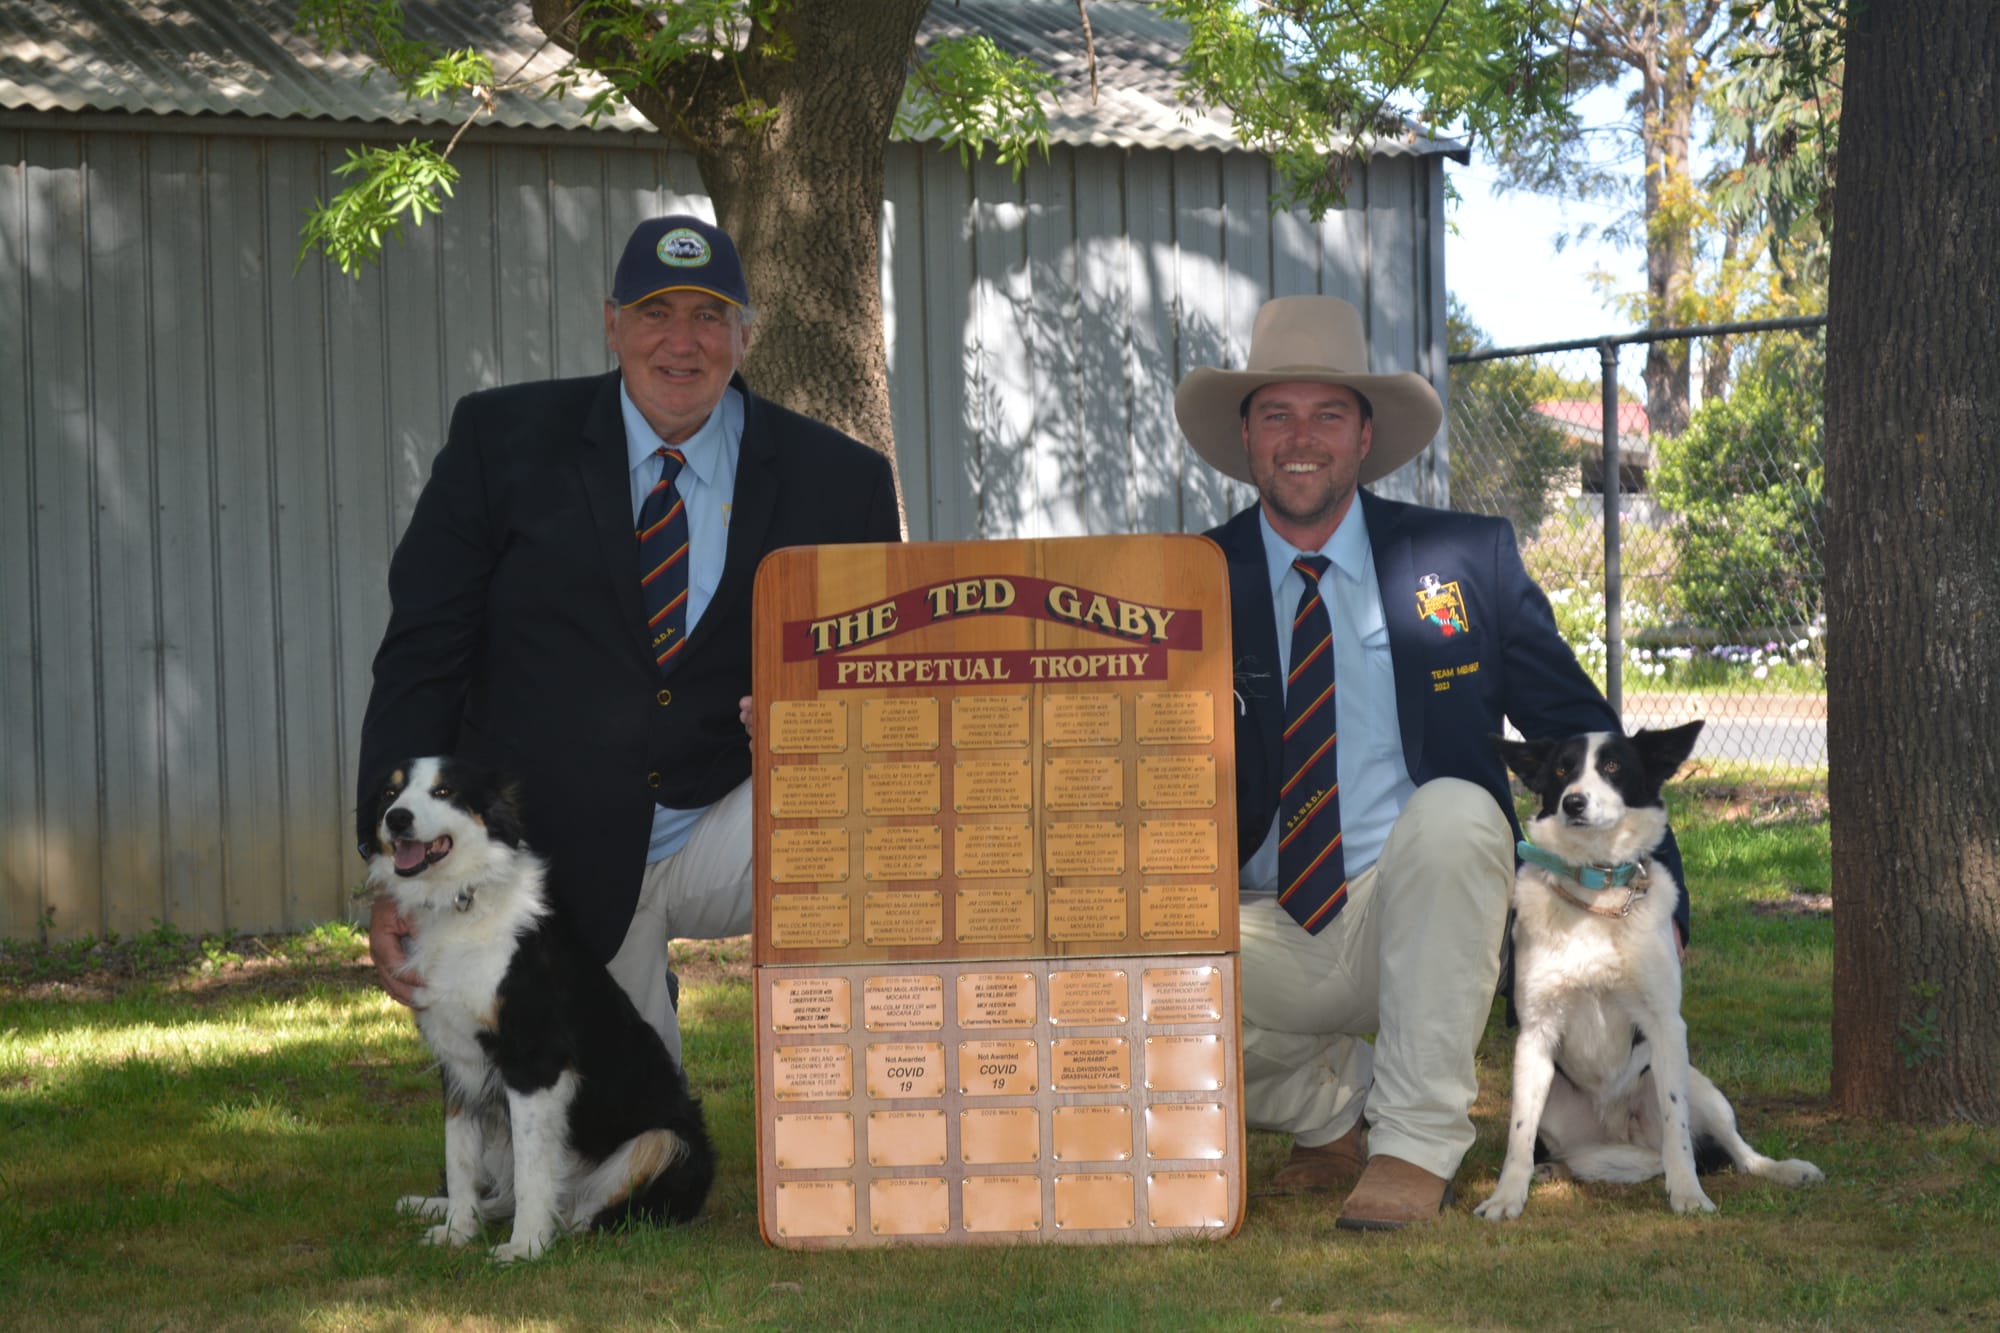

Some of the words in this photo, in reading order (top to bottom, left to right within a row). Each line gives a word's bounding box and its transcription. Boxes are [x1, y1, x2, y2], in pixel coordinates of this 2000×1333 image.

[809, 600, 899, 652] THE
[928, 579, 1016, 616] TED
[1048, 586, 1176, 642] GABY
[837, 656, 1010, 683] PERPETUAL
[1031, 653, 1149, 679] TROPHY
[1431, 667, 1454, 680] TEAM
[887, 1067, 925, 1078] COVID
[980, 1064, 1017, 1075] COVID
[900, 1081, 912, 1092] 19
[993, 1078, 1005, 1089] 19
